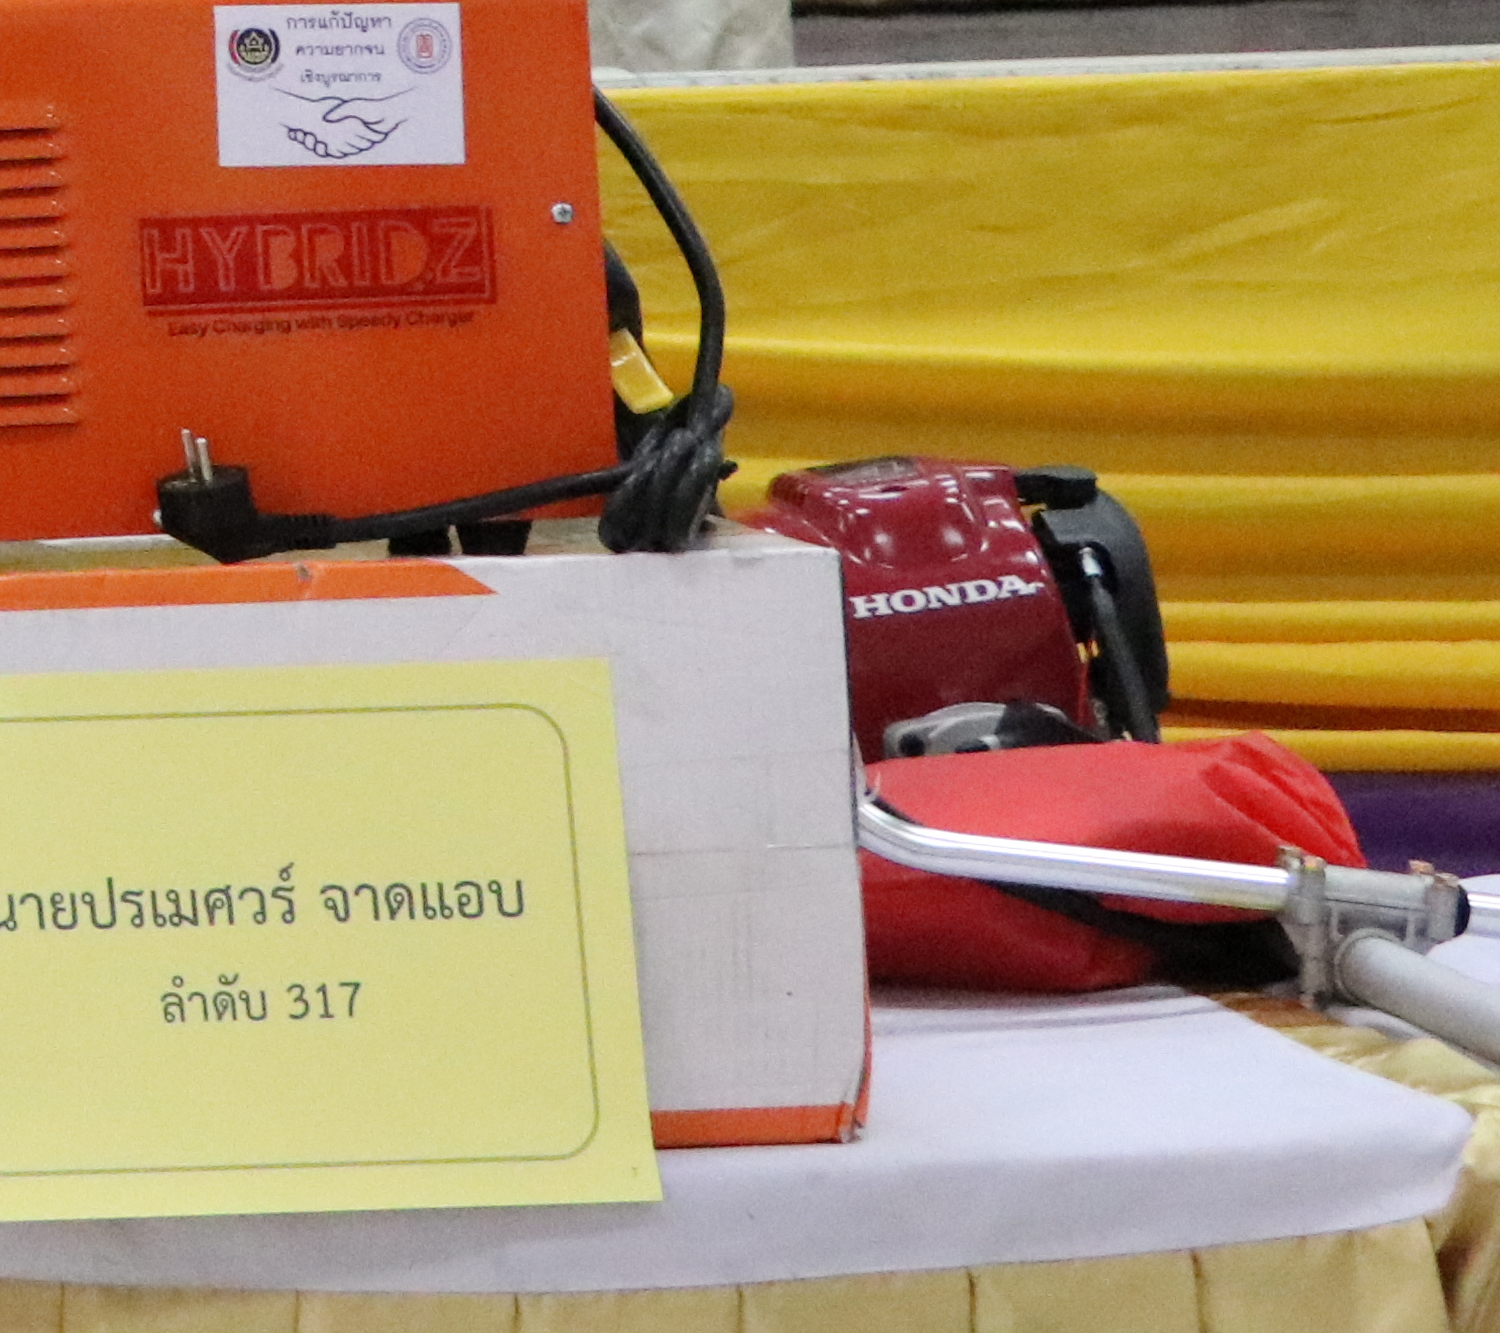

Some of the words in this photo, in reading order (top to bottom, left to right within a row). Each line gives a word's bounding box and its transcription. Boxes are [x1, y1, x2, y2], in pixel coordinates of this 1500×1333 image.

[286, 10, 392, 34] การแก้ปัญหา
[850, 575, 1029, 619] HONDA
[320, 876, 526, 924] จาดแอบ
[161, 974, 268, 1024] ลำดับ
[287, 981, 362, 1020] 317
